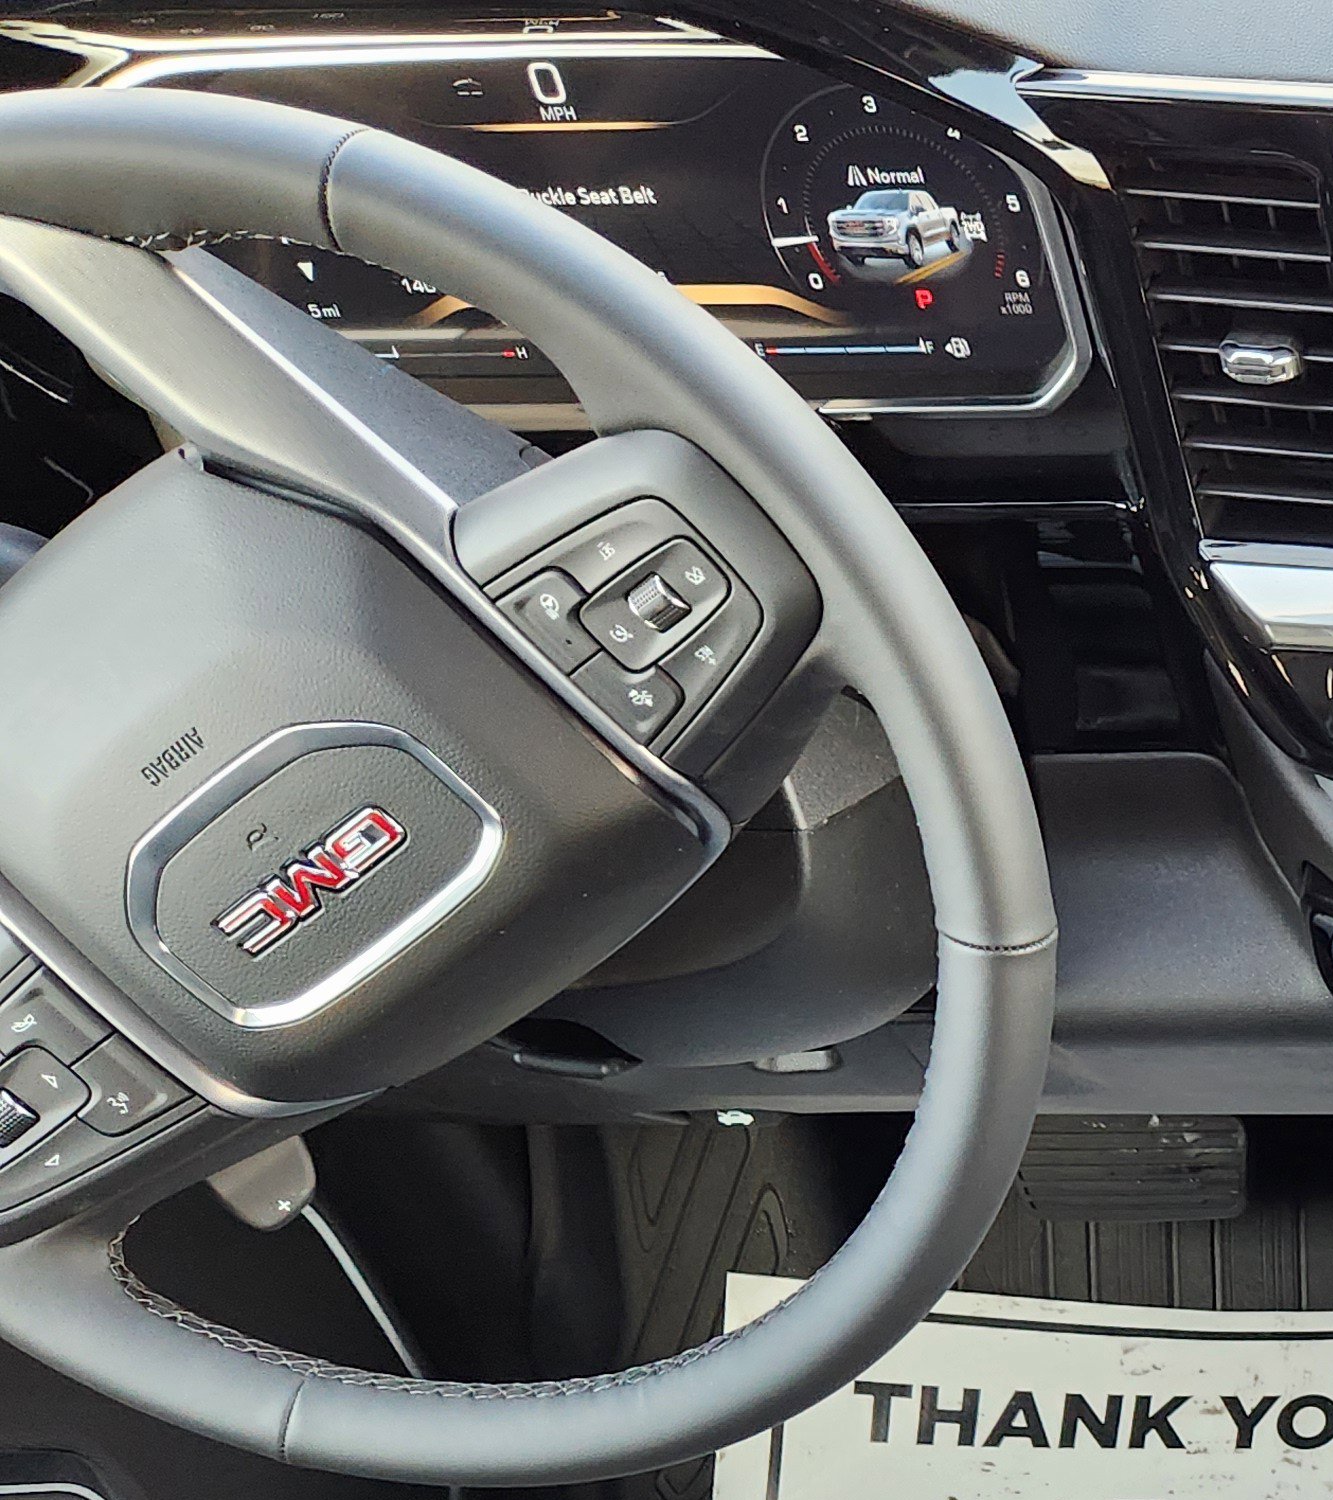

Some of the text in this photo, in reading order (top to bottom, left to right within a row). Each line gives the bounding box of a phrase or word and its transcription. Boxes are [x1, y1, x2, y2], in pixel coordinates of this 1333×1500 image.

[527, 62, 567, 105] 0
[539, 105, 578, 121] MPH
[862, 95, 877, 114] 3
[794, 124, 810, 142] 2
[866, 165, 925, 185] Normal
[576, 186, 619, 205] Seat
[618, 185, 658, 205] Belt
[1006, 194, 1022, 213] 5
[776, 196, 789, 214] 1
[808, 272, 824, 291] 0
[1015, 269, 1031, 288] 6
[914, 289, 933, 310] P
[1004, 291, 1031, 304] RPM
[307, 303, 322, 319] 5
[1001, 302, 1033, 315] x1000
[516, 347, 529, 360] H
[754, 342, 766, 357] E
[925, 340, 935, 355] F
[140, 725, 206, 787] AIRBAG
[209, 803, 409, 958] GMC
[853, 1381, 1192, 1450] THANK
